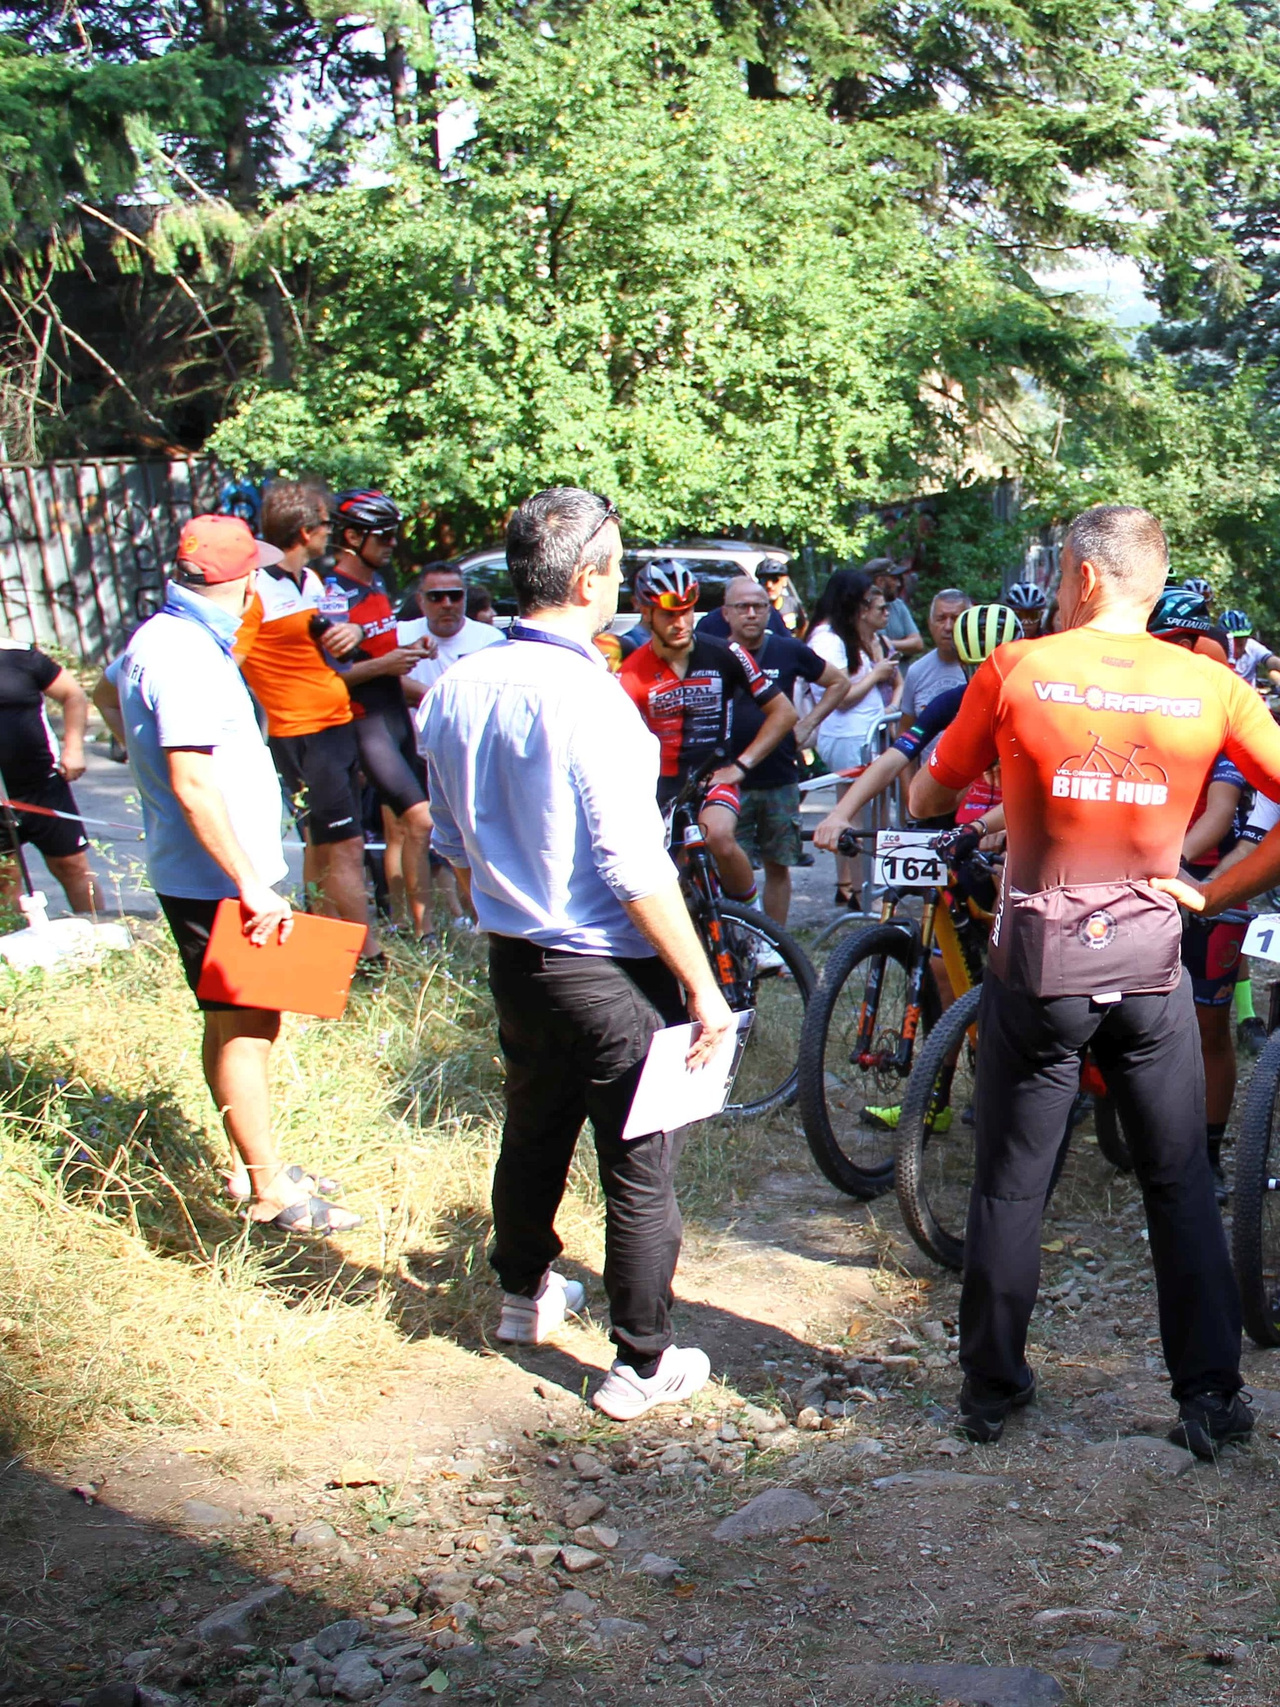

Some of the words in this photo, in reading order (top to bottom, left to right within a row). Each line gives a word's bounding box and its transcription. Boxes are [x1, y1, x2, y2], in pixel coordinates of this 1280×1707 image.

[655, 687, 713, 703] SOUDAL
[1052, 776, 1112, 801] BIKE
[1116, 780, 1169, 806] HUB
[883, 857, 941, 881] 164
